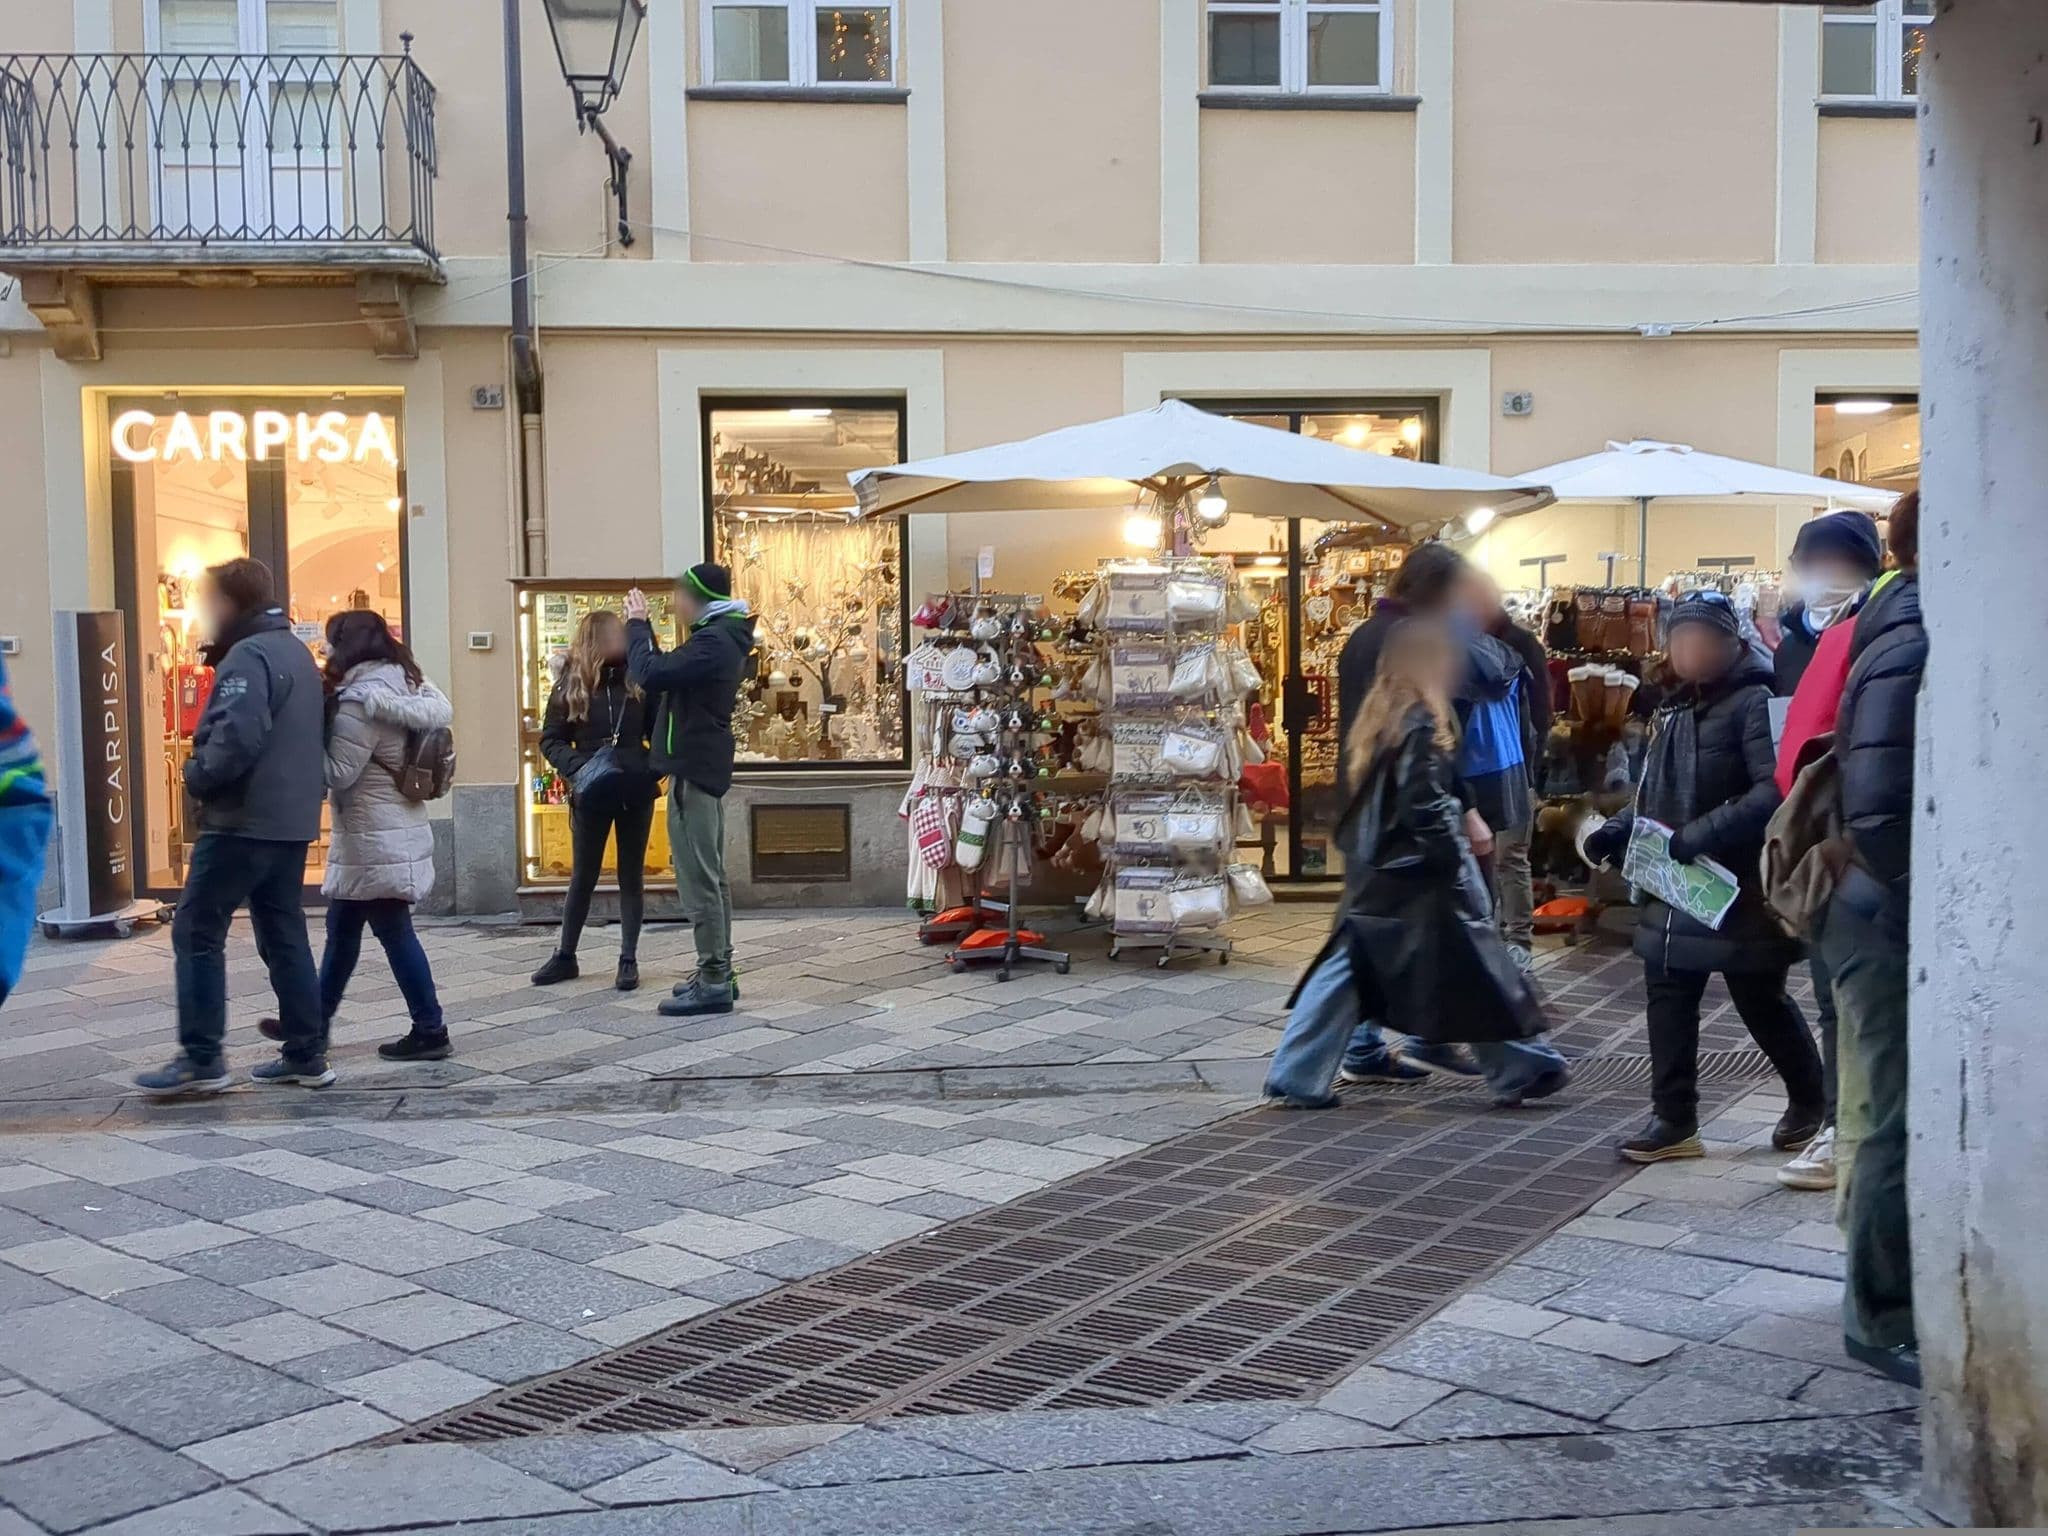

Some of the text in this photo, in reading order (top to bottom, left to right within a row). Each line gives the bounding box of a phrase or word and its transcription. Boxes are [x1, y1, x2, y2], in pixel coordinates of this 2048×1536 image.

[1511, 395, 1523, 412] 6
[110, 410, 397, 464] CARPISA
[101, 642, 124, 824] CARPISA
